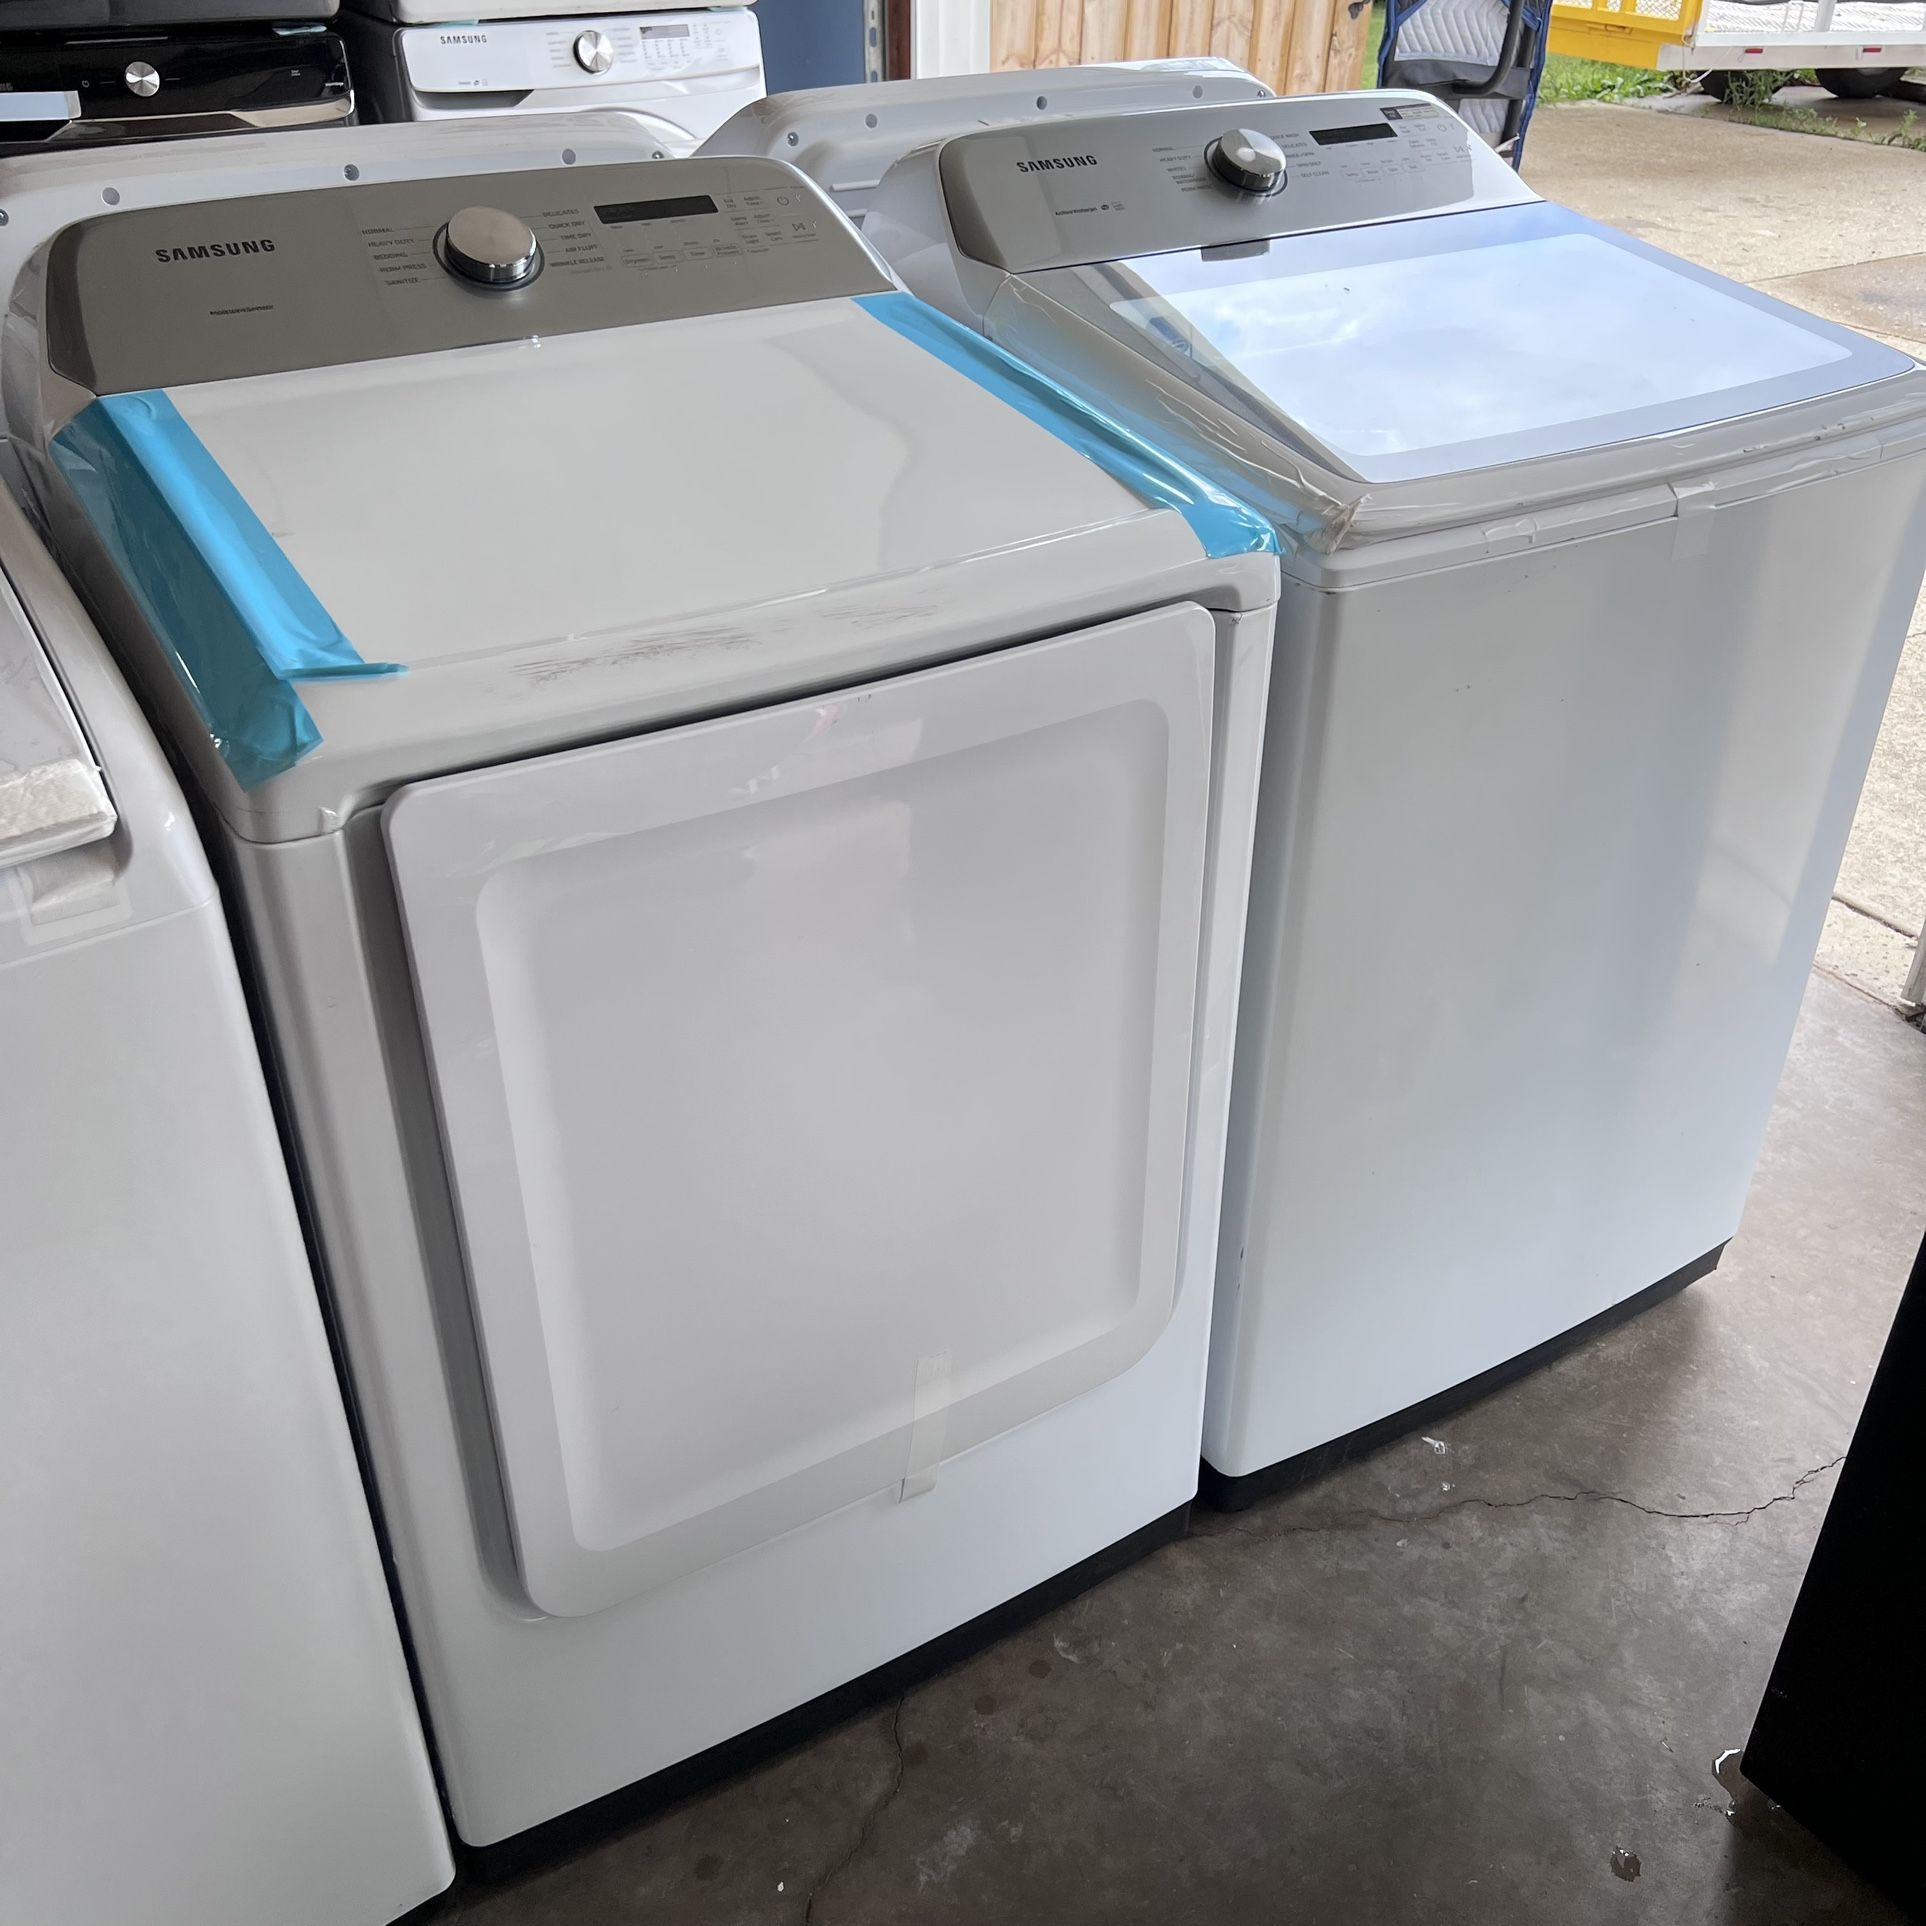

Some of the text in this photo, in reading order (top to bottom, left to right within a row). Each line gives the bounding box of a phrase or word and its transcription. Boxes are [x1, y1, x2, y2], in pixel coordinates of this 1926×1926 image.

[440, 34, 488, 45] SAMSUNG
[1016, 154, 1098, 173] SAMSUNG
[155, 239, 277, 263] SAMSUNG
